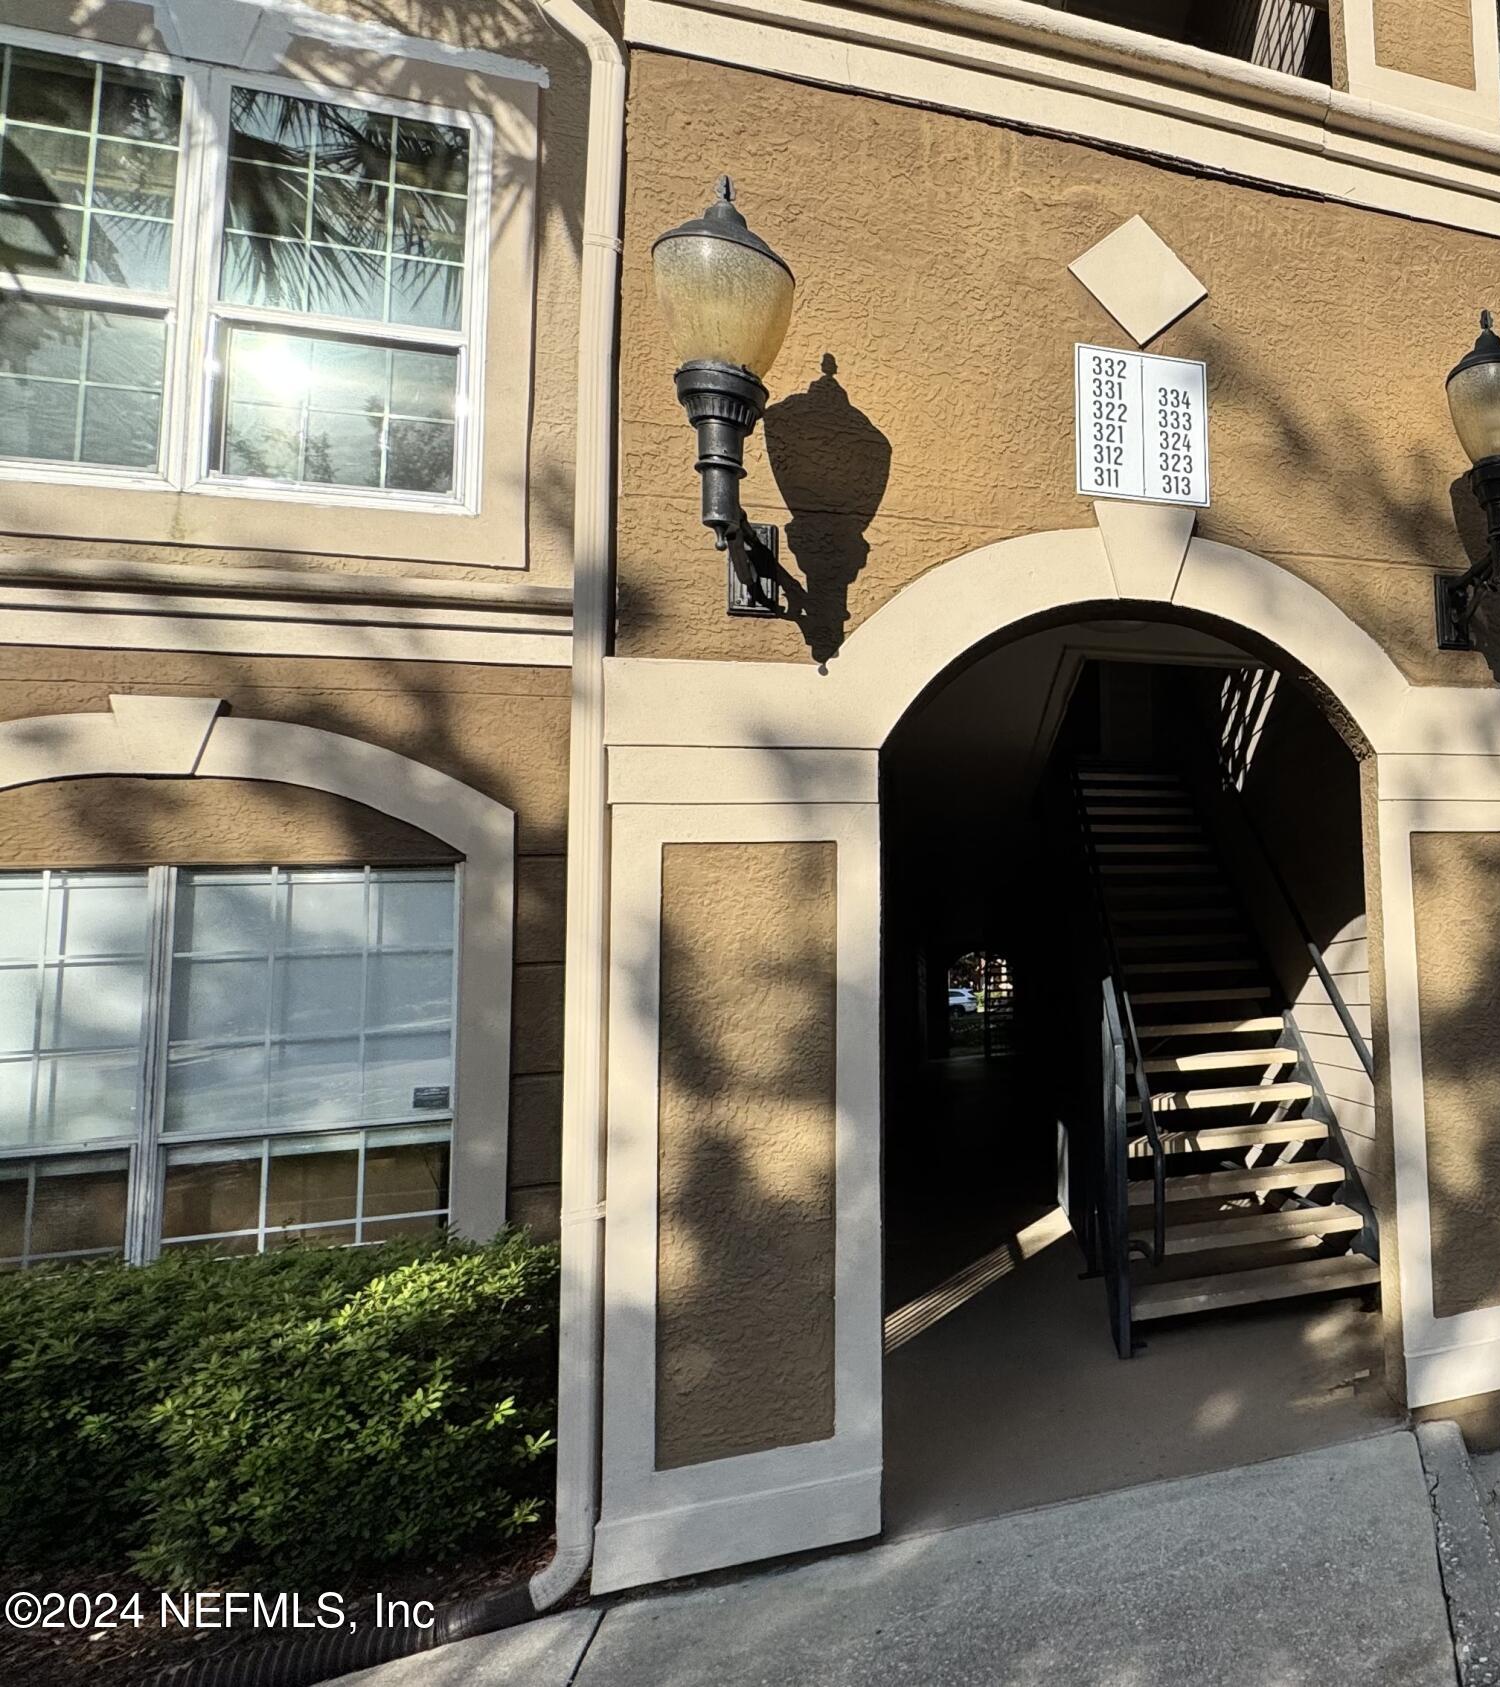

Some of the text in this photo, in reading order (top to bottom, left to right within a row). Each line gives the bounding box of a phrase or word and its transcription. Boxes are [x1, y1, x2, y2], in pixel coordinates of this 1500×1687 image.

[1093, 356, 1126, 379] 332
[1093, 378, 1122, 400] 331
[1159, 387, 1191, 409] 334
[1093, 400, 1127, 422] 322
[1159, 409, 1192, 431] 333
[1094, 422, 1123, 444] 321
[1160, 431, 1191, 452] 324
[1094, 444, 1123, 466] 312
[1160, 453, 1193, 473] 323
[1094, 467, 1119, 488] 311
[1162, 475, 1191, 495] 313
